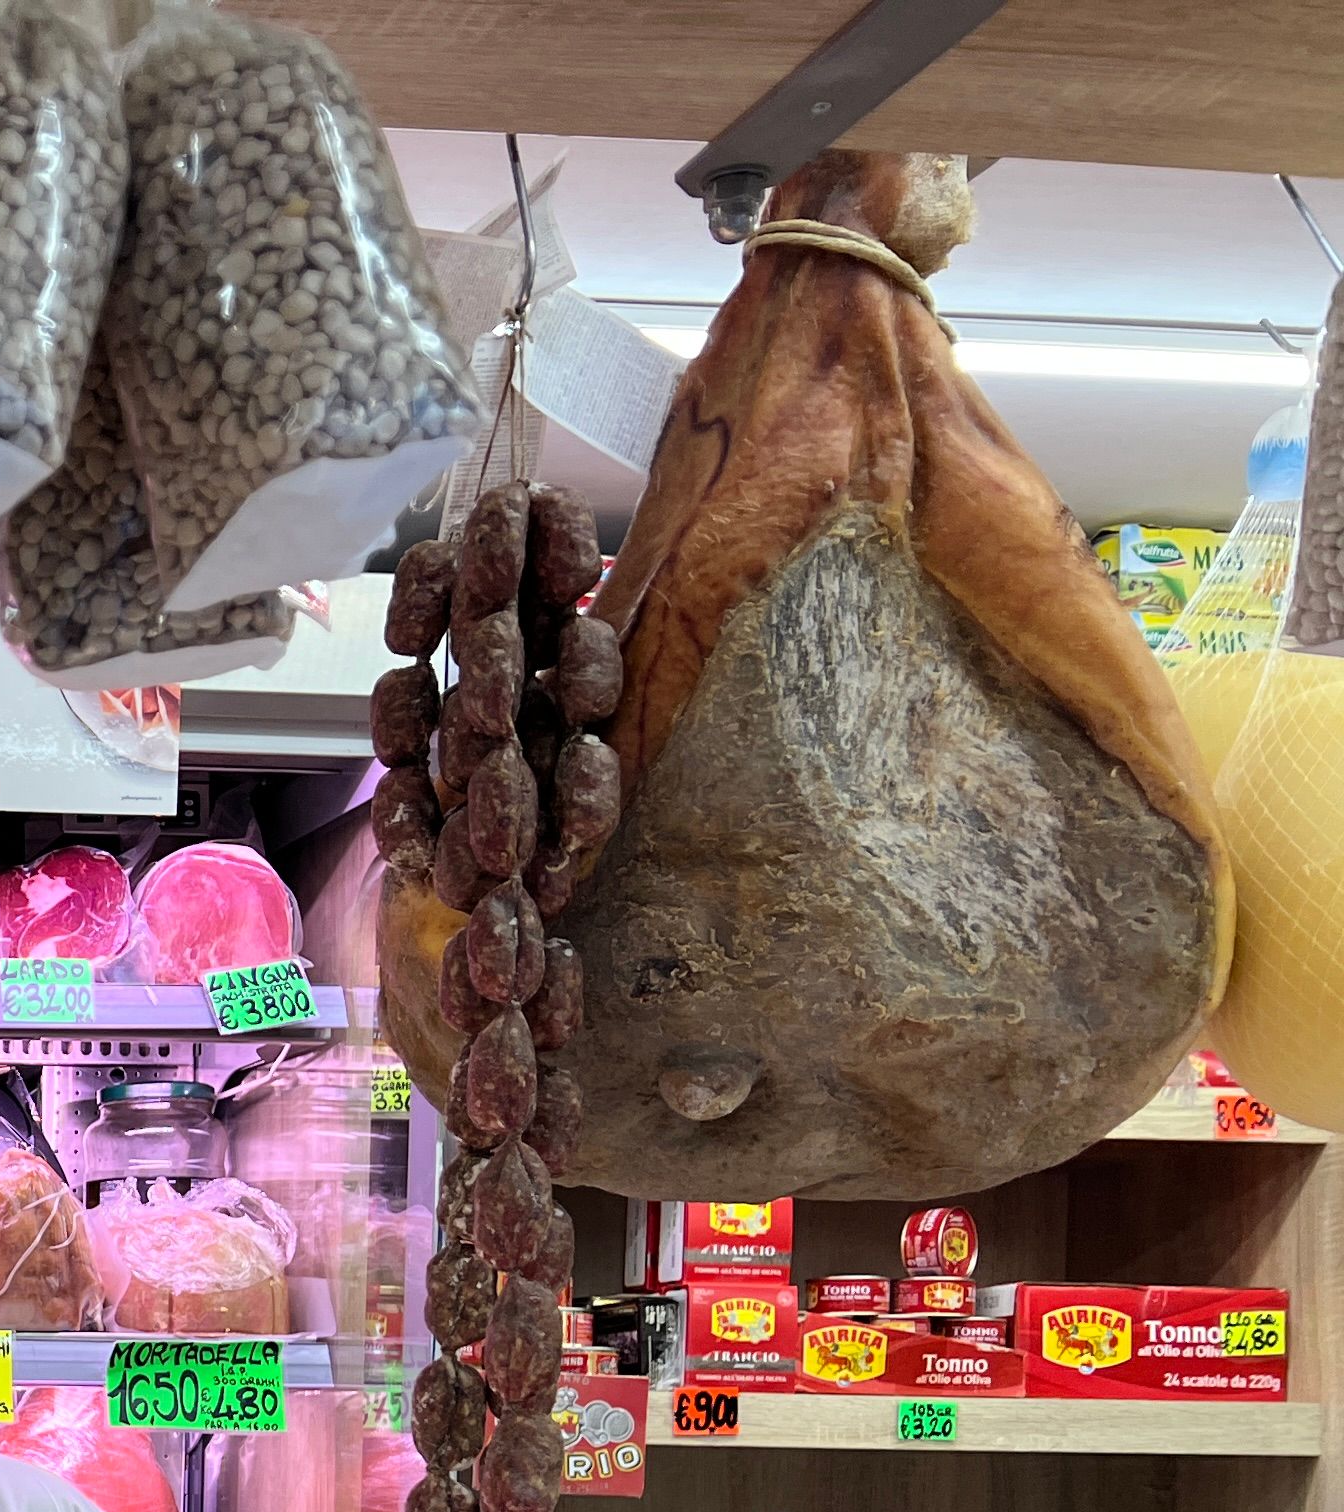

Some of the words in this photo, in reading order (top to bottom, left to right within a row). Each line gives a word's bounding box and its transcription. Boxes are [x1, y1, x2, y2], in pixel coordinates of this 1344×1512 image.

[0, 959, 85, 982] LARDO
[822, 1284, 871, 1296] TONNO
[714, 1300, 773, 1315] AURIGA
[1048, 1306, 1127, 1333] AURIGA
[808, 1327, 884, 1351] AURIGA
[110, 1338, 280, 1367] MORTADELLA
[922, 1353, 989, 1374] Tonno
[1163, 1372, 1178, 1388] 24
[1180, 1374, 1220, 1390] scatole
